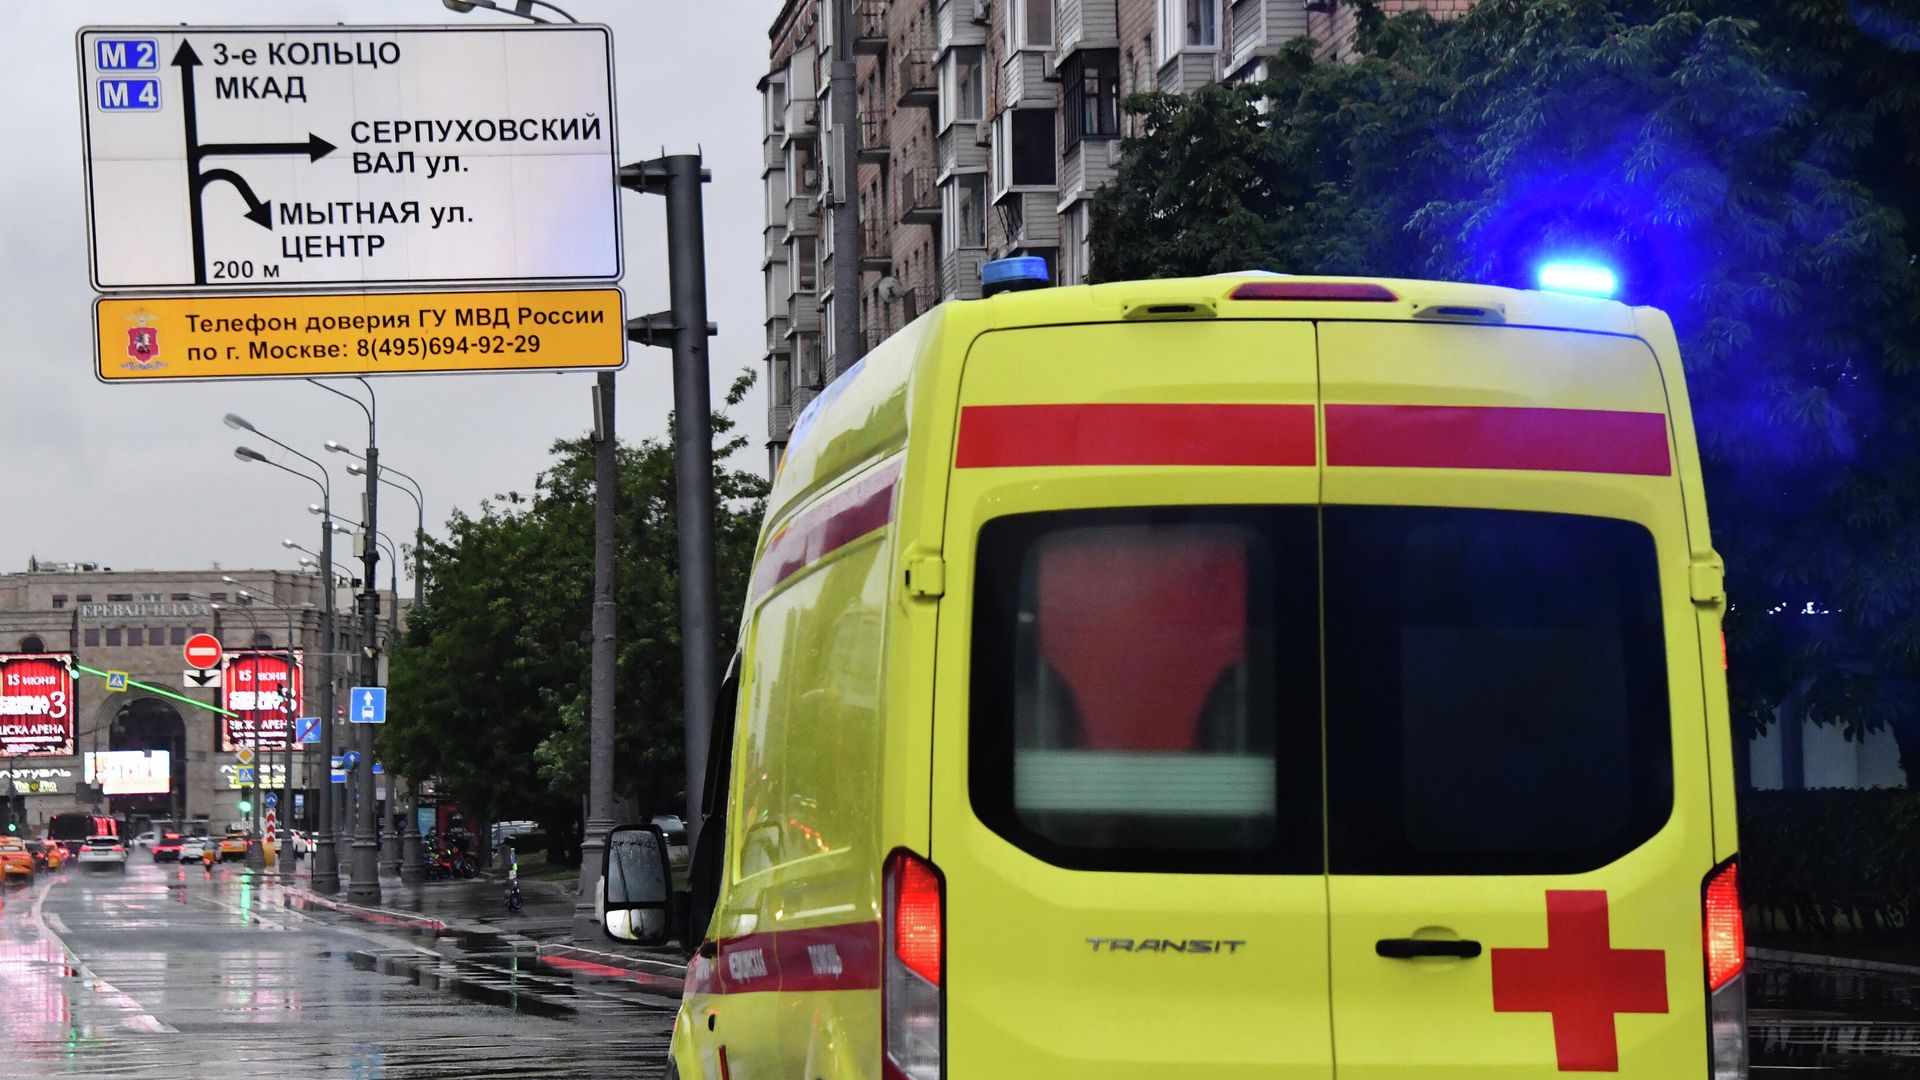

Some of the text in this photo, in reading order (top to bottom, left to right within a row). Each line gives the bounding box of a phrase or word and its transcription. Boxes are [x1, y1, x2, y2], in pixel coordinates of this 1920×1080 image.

[136, 43, 154, 68] 2
[213, 41, 400, 69] 3-е КОЛЬЦО
[138, 81, 157, 106] 4
[215, 75, 308, 103] МКАД
[350, 112, 601, 144] СЕРПУХОВСКИЙ
[352, 151, 469, 178] ВАЛ ул.
[279, 201, 474, 229] МЫТНАЯ ул.
[281, 234, 386, 262] ЦЕНТР
[213, 260, 280, 279] 200 м
[185, 307, 604, 336] Телефон доверия ГУ МВД России
[187, 334, 541, 361] по г. Москве: 8(495)694-92-29
[82, 604, 146, 617] ЕРЕВАН
[7, 674, 20, 686] 15
[49, 691, 67, 718] 3
[30, 724, 66, 735] АРЕНА
[1086, 937, 1246, 954] TRANSIT
